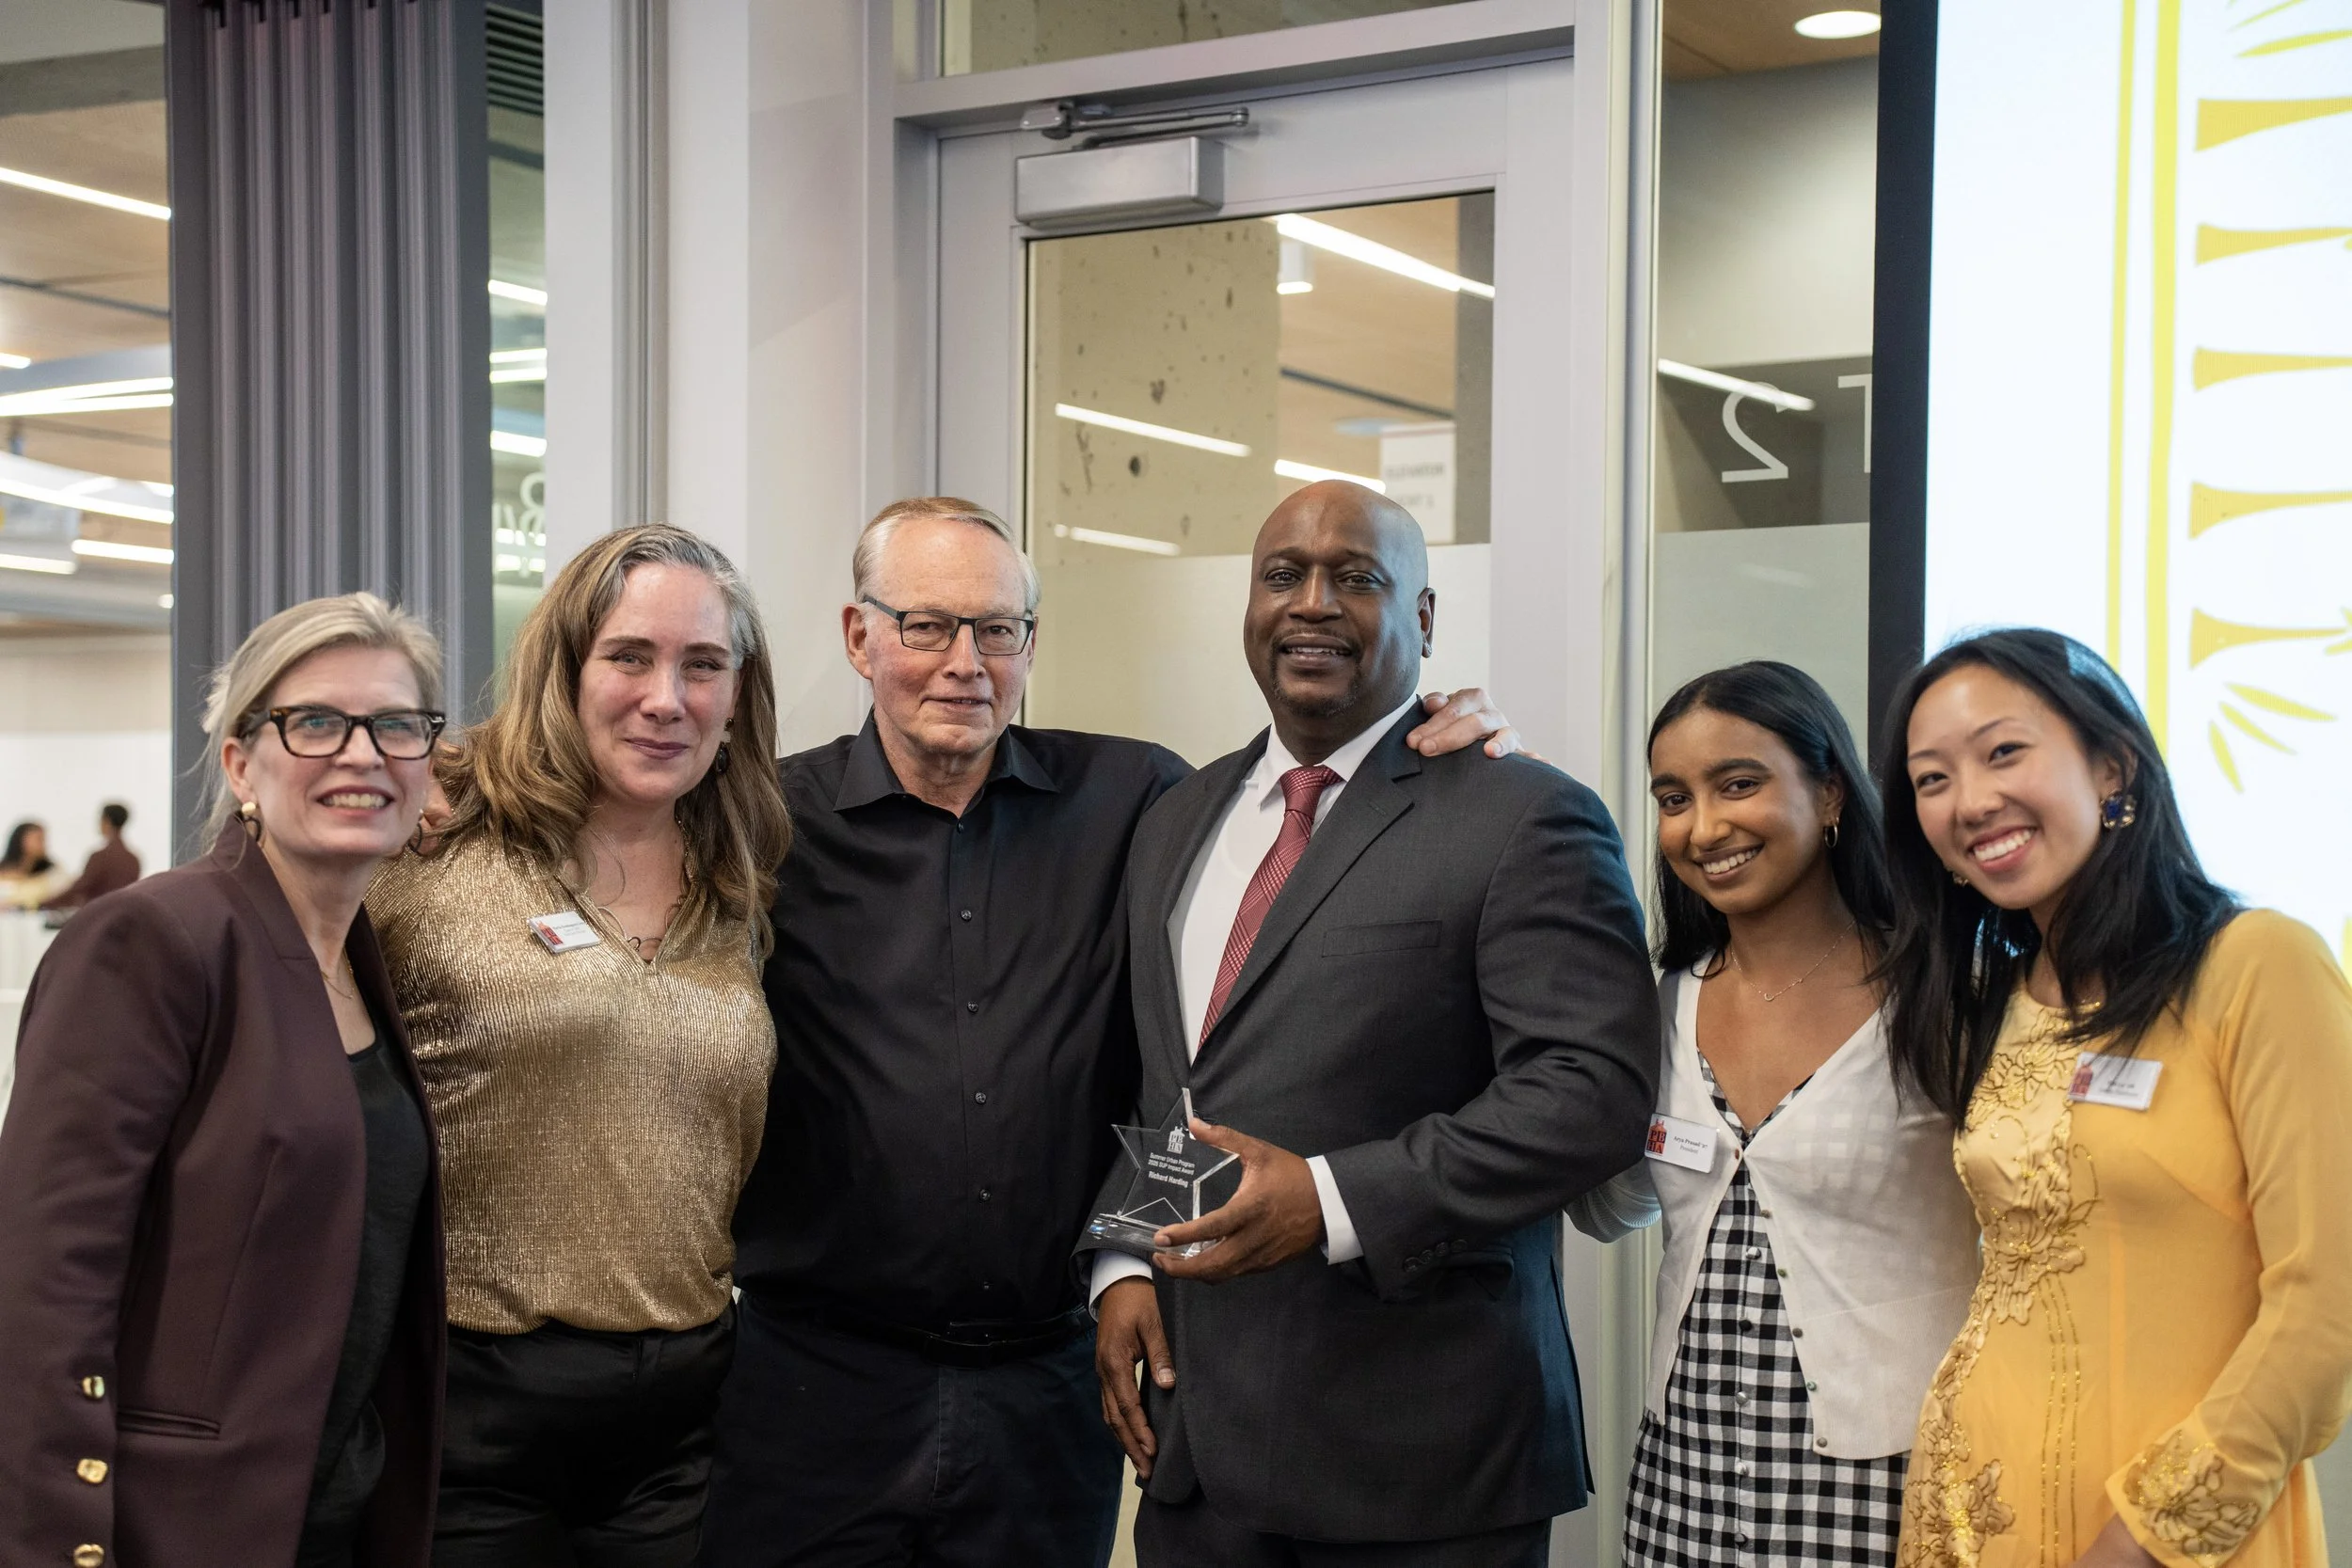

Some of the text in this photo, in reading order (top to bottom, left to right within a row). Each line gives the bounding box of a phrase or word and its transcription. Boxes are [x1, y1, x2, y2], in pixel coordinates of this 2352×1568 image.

[1150, 1152, 1196, 1168] Summer Urban Program
[1168, 1164, 1182, 1172] Impact
[1182, 1166, 1195, 1176] Award
[1149, 1170, 1188, 1188] Richard Harding
